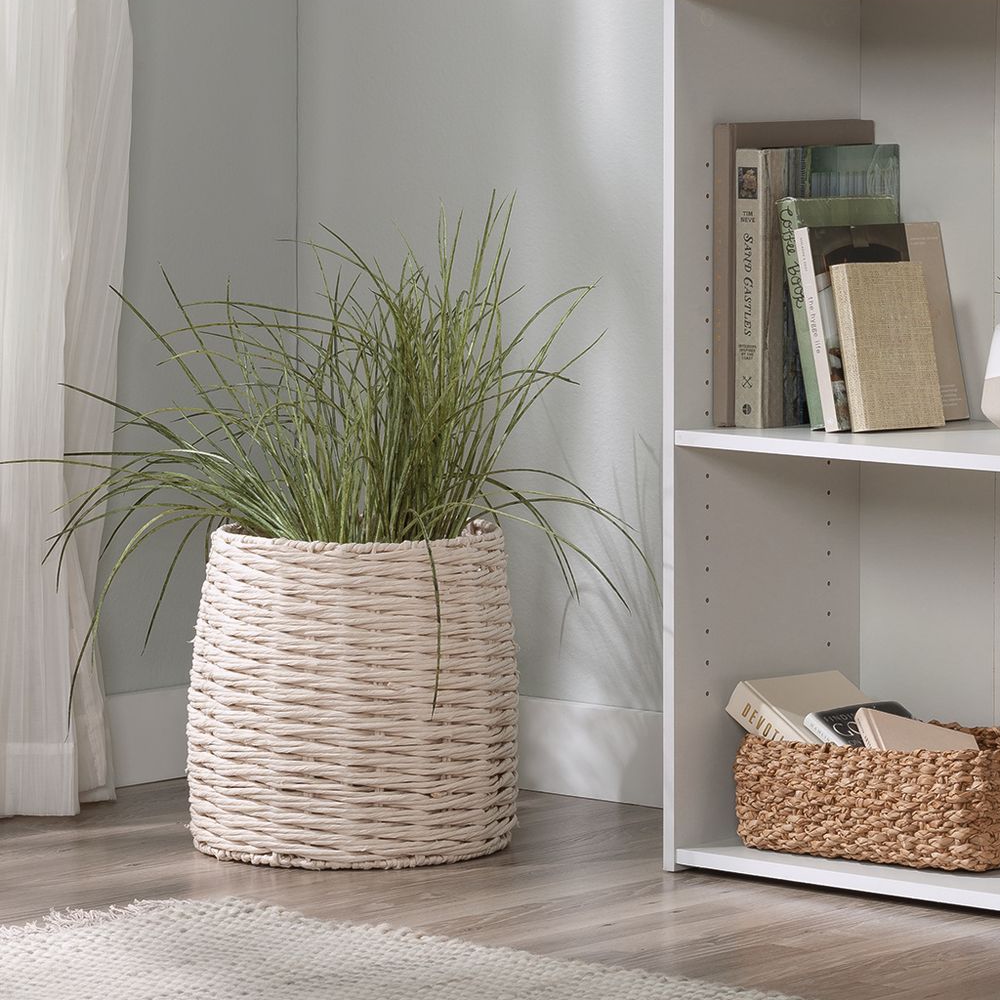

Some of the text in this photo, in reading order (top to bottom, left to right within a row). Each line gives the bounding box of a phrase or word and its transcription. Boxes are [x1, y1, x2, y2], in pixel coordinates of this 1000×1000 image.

[742, 233, 754, 338] SAND CASTLES
[808, 314, 819, 338] hygge
